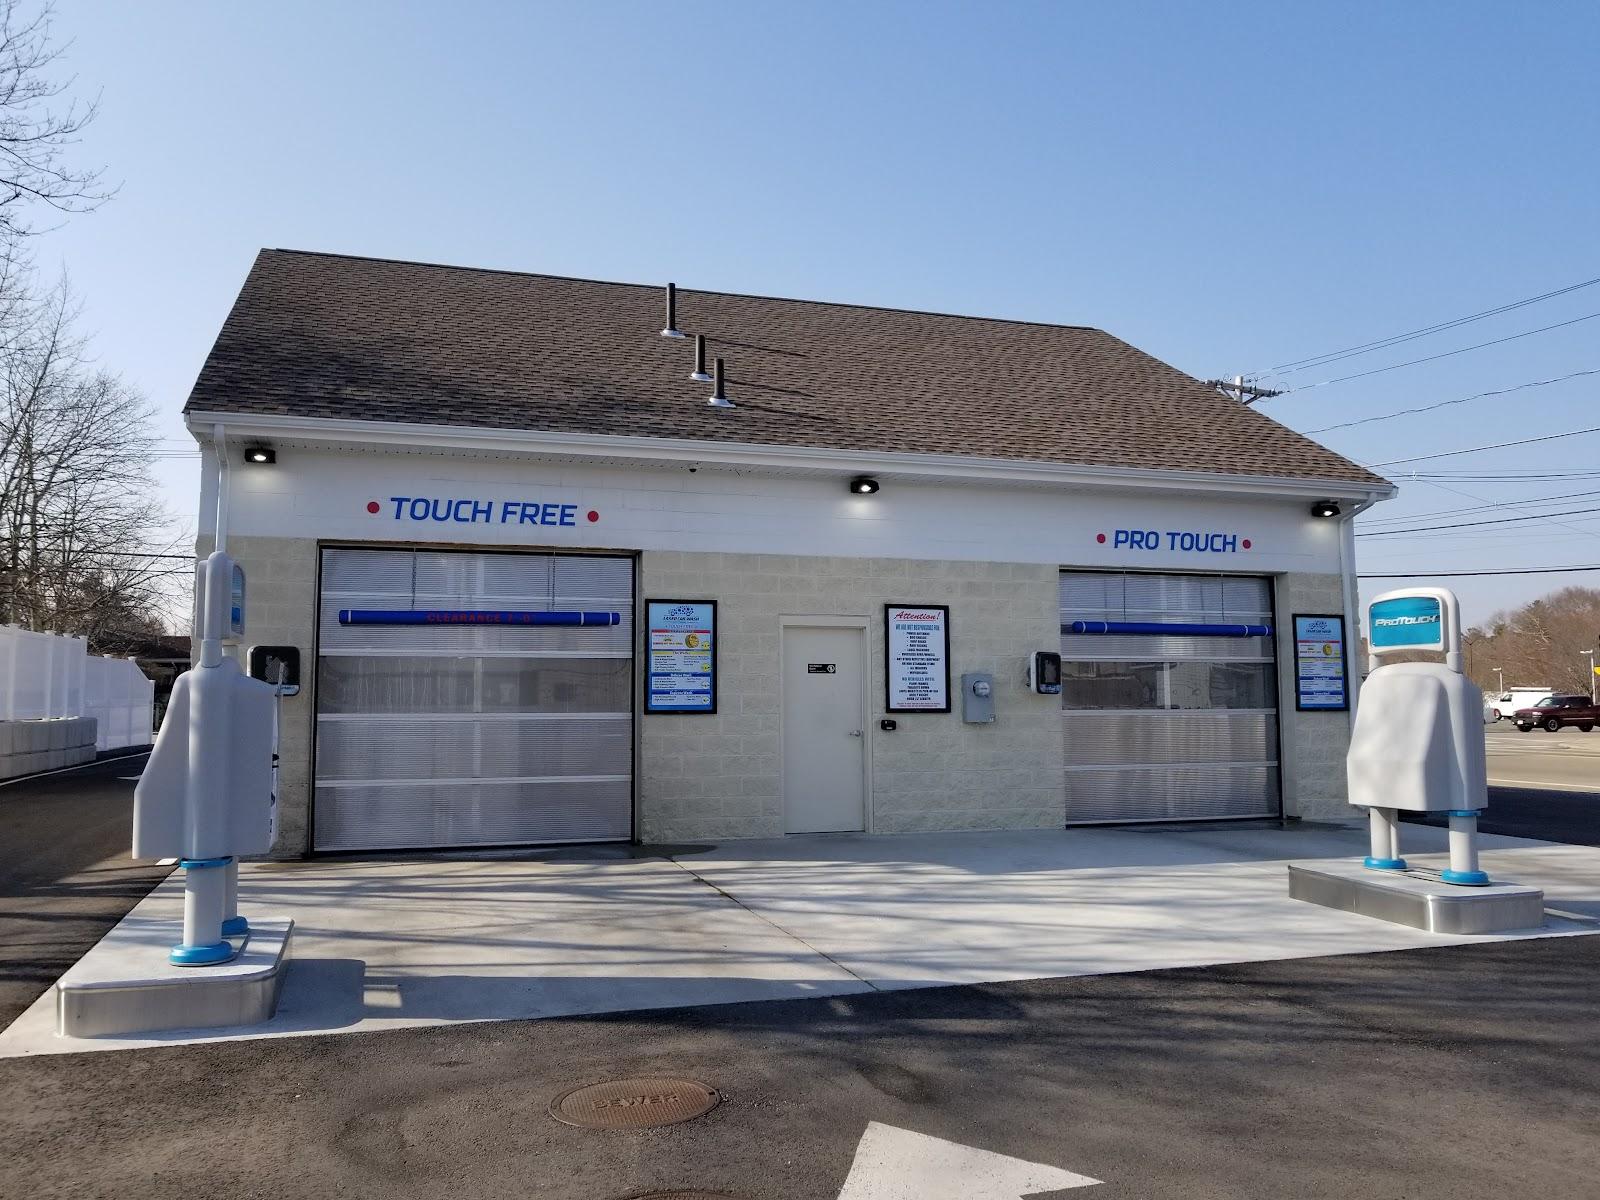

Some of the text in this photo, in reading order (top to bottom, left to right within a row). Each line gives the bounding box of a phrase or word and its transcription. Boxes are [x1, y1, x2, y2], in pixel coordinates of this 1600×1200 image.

[390, 497, 578, 526] TOUCH FREE
[1113, 529, 1237, 553] PRO TOUCH
[427, 612, 501, 624] CLEARANCE
[893, 610, 941, 620] Attention!
[592, 1093, 679, 1110] SEWER
